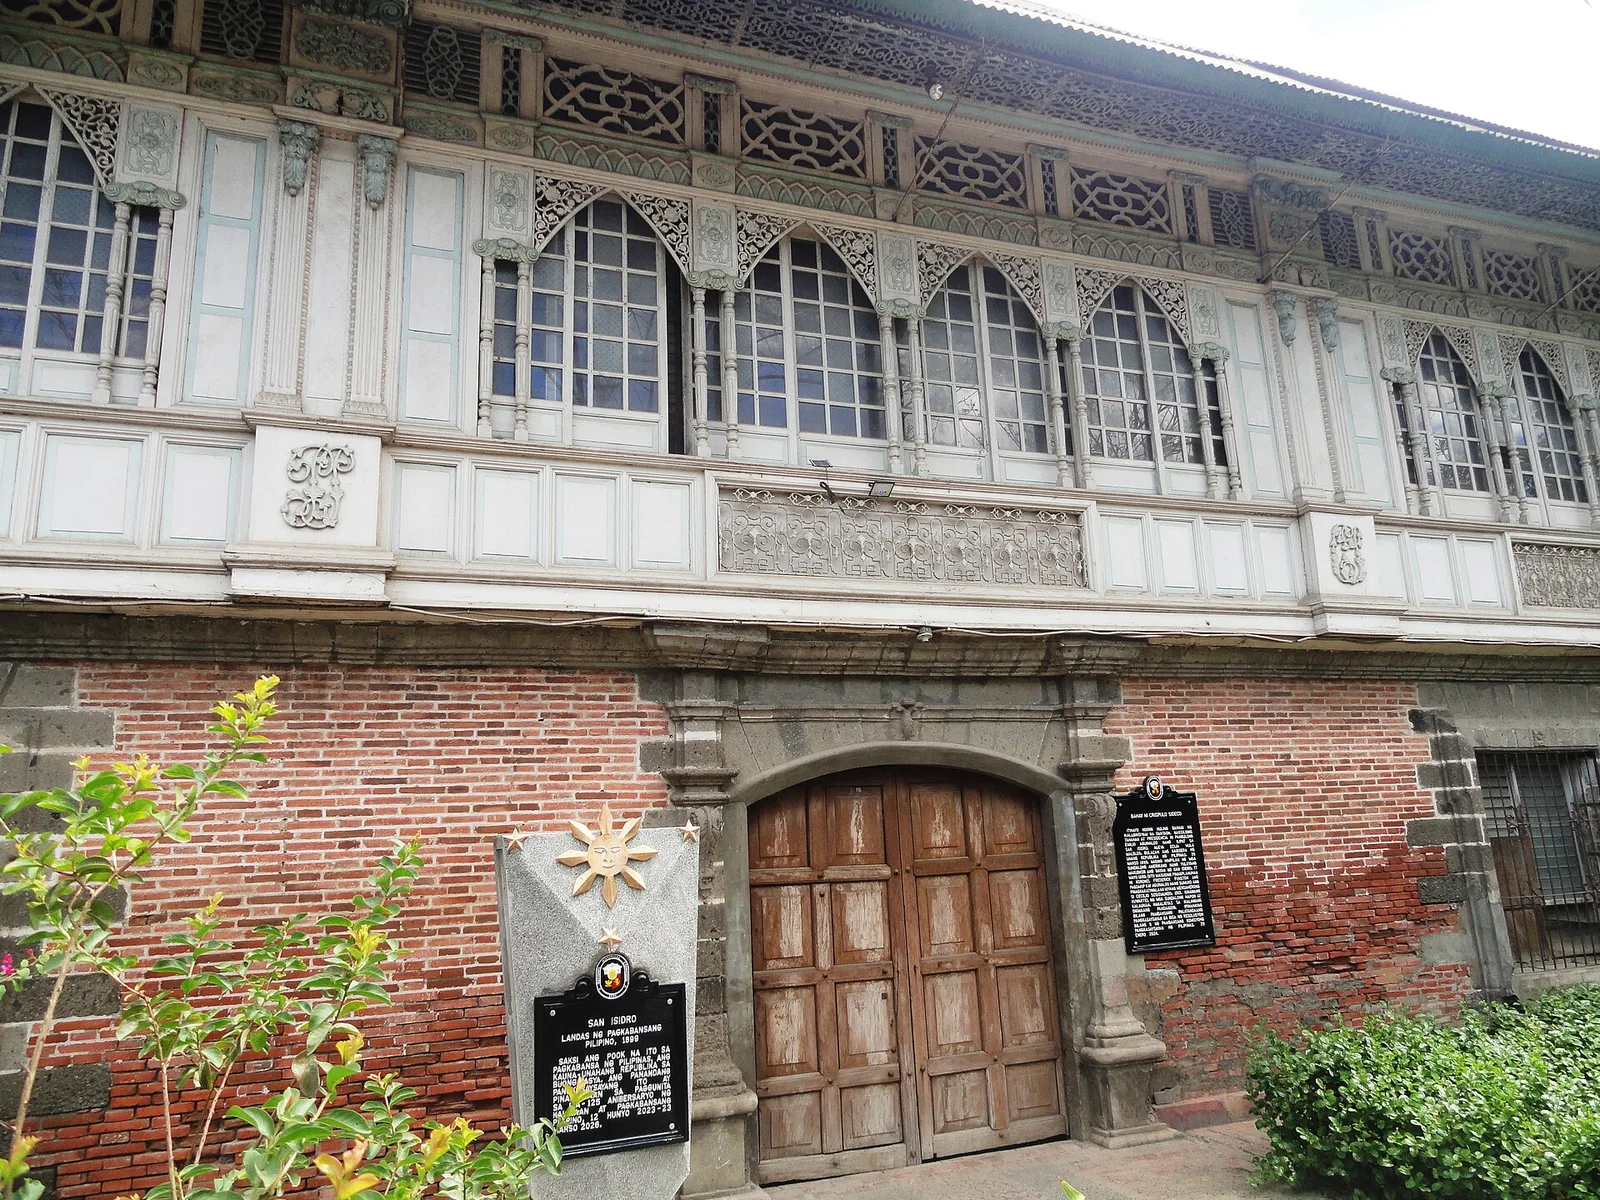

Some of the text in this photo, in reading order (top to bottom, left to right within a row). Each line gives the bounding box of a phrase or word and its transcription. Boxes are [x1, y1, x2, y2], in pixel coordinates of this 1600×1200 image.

[588, 1015, 637, 1028] SAN ISIDRO
[561, 1024, 662, 1042] LANDAS NG PAGKABANSANG
[585, 1035, 639, 1048] PILIPINO, 1899
[553, 1061, 599, 1074] PAGKABANSA
[619, 1055, 653, 1066] PILIPINAS,
[656, 1053, 670, 1061] ANG
[559, 1056, 579, 1065] SAKSI
[584, 1054, 600, 1062] ANG
[607, 1051, 625, 1060] POOK
[553, 1067, 614, 1081] KAUNA-UNAHANG
[620, 1062, 658, 1073] REPUBLIKA
[608, 1073, 623, 1082] ANG
[630, 1067, 670, 1079] PANANDANG
[635, 1082, 671, 1093] PAGGUNITA
[636, 1078, 648, 1086] ITO
[553, 1103, 563, 1111] SA
[607, 1092, 654, 1104] ANIBERSARYO
[617, 1096, 671, 1110] PAGKABANSANG
[607, 1110, 630, 1119] HUNYO
[555, 1124, 578, 1134] ARSO
